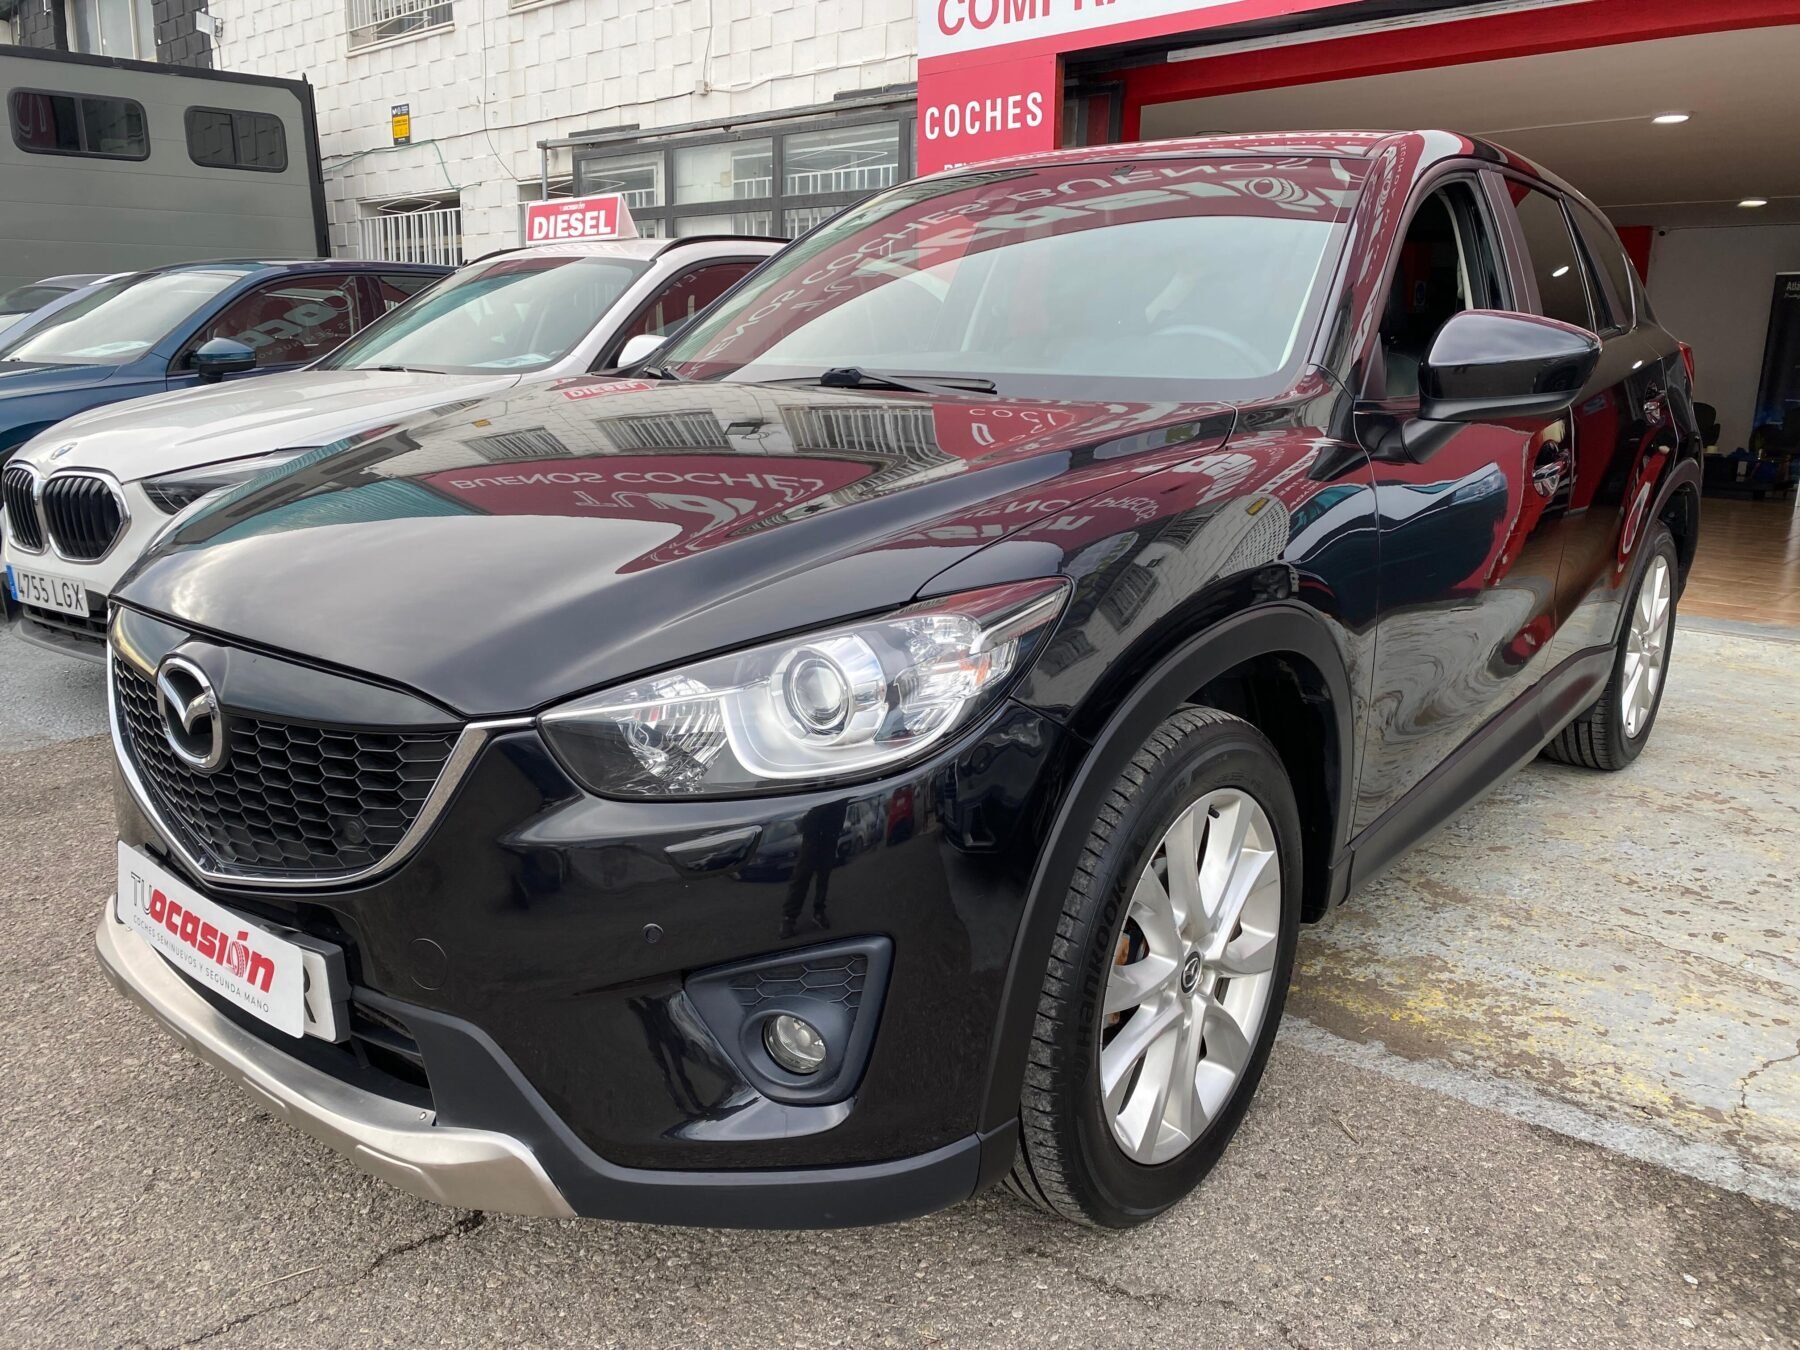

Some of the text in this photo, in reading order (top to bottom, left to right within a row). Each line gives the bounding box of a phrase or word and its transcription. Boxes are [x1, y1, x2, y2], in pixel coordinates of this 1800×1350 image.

[924, 91, 1043, 140] COCHES
[532, 210, 611, 240] DIESEL
[17, 571, 84, 612] 4755 LGX
[133, 914, 270, 1013] COCHES SEMINUEVOS Y SEGUNDA MANO
